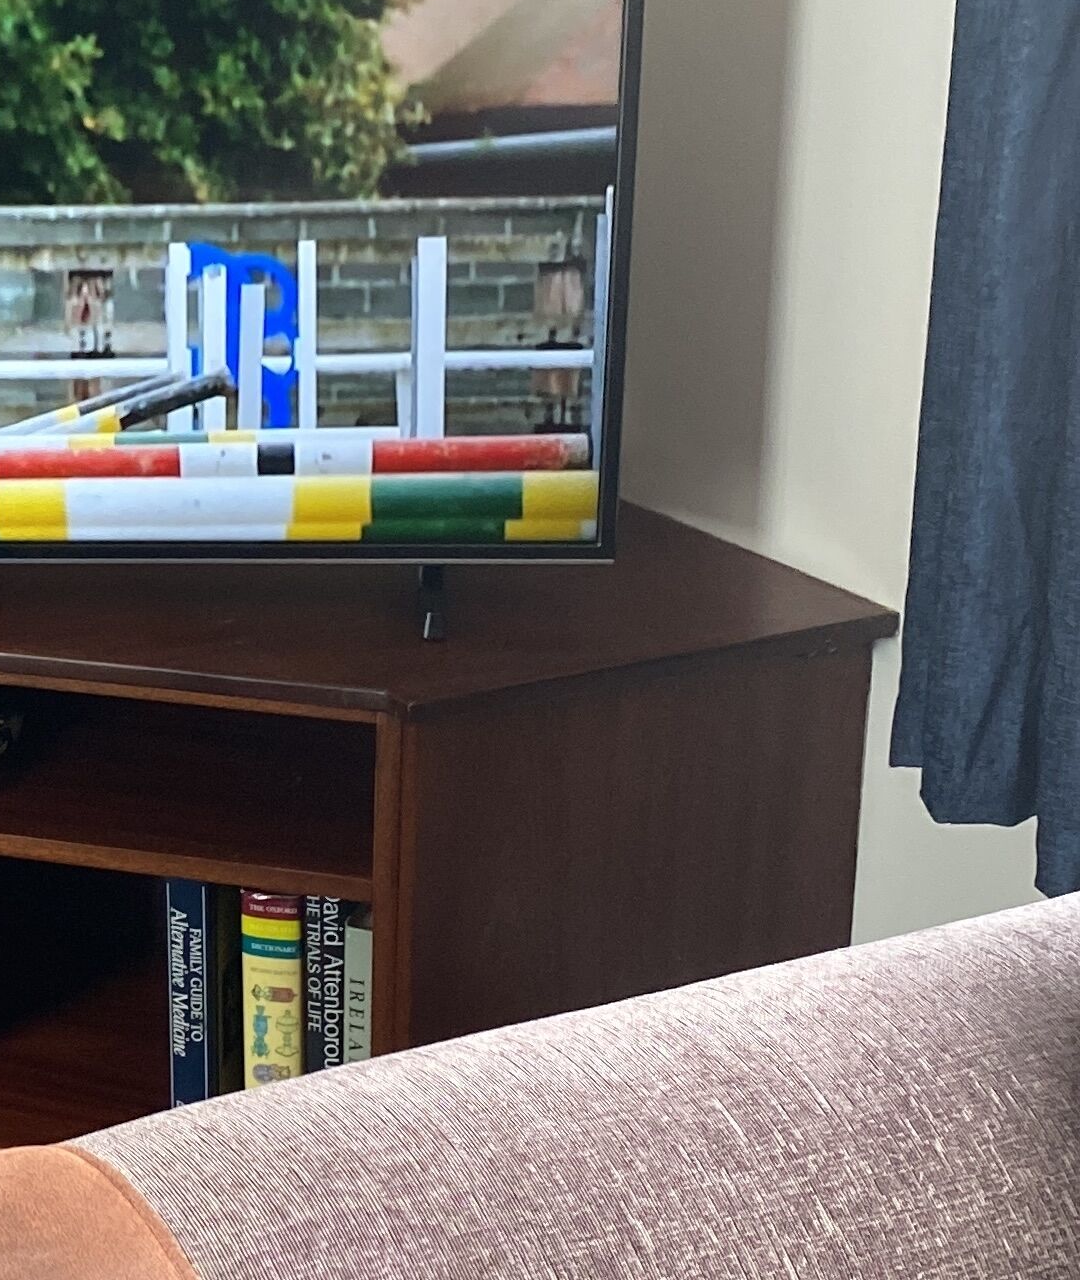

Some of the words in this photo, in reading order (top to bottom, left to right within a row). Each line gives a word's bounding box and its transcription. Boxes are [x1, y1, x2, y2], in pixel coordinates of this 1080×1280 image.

[306, 895, 320, 917] HE
[170, 907, 189, 989] Alternative
[189, 928, 203, 975] FAMILY
[250, 942, 298, 953] DICTIONARY
[307, 923, 321, 974] TRIALS
[190, 977, 204, 1020] GUIDE
[307, 977, 321, 999] OF
[172, 991, 191, 1057] Medicine
[190, 1022, 204, 1042] TO
[307, 1001, 322, 1033] LIFE
[323, 953, 344, 1069] Attenborou
[349, 978, 365, 1062] IRELA
